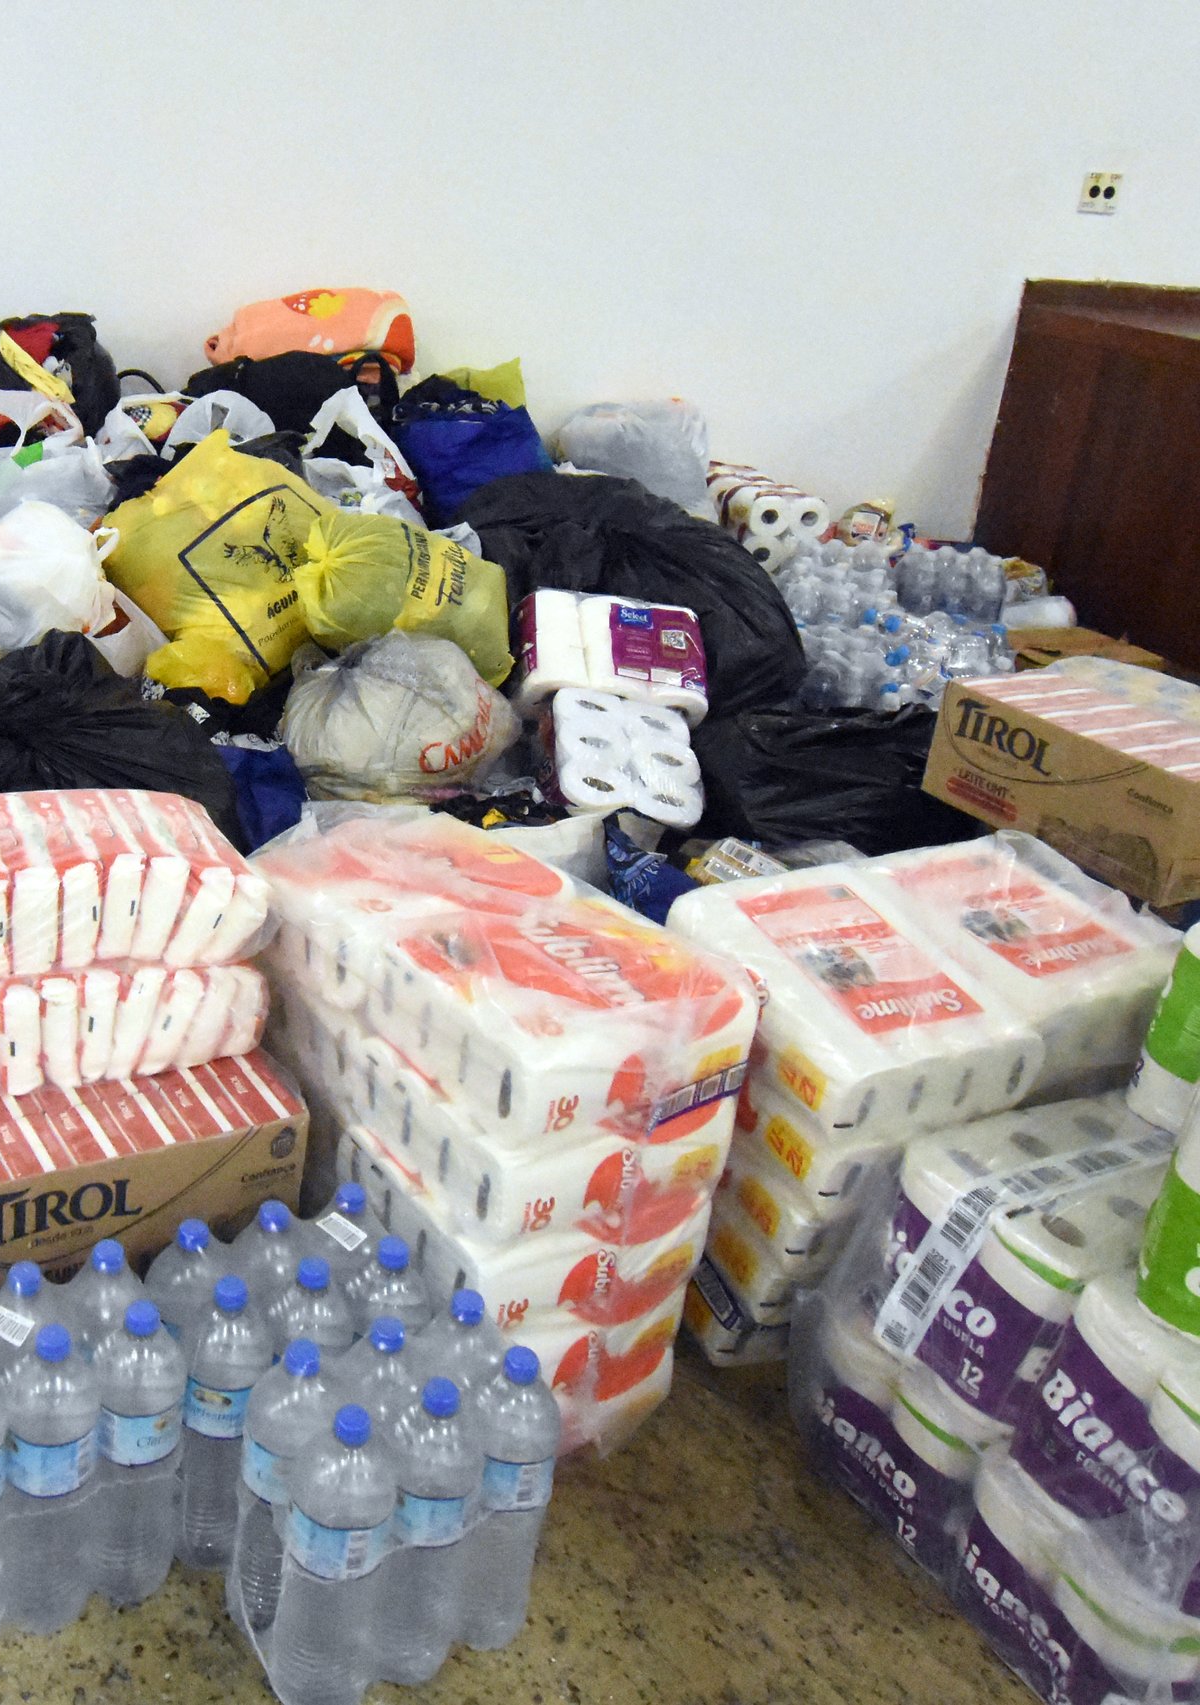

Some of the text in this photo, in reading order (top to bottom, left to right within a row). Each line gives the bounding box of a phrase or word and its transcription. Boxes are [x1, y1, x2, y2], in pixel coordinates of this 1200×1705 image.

[620, 608, 648, 622] Select
[954, 698, 1052, 776] TIROL
[554, 1094, 579, 1132] 30
[531, 1196, 555, 1233] 30
[960, 1357, 985, 1387] 12
[1041, 1367, 1188, 1523] Bianco
